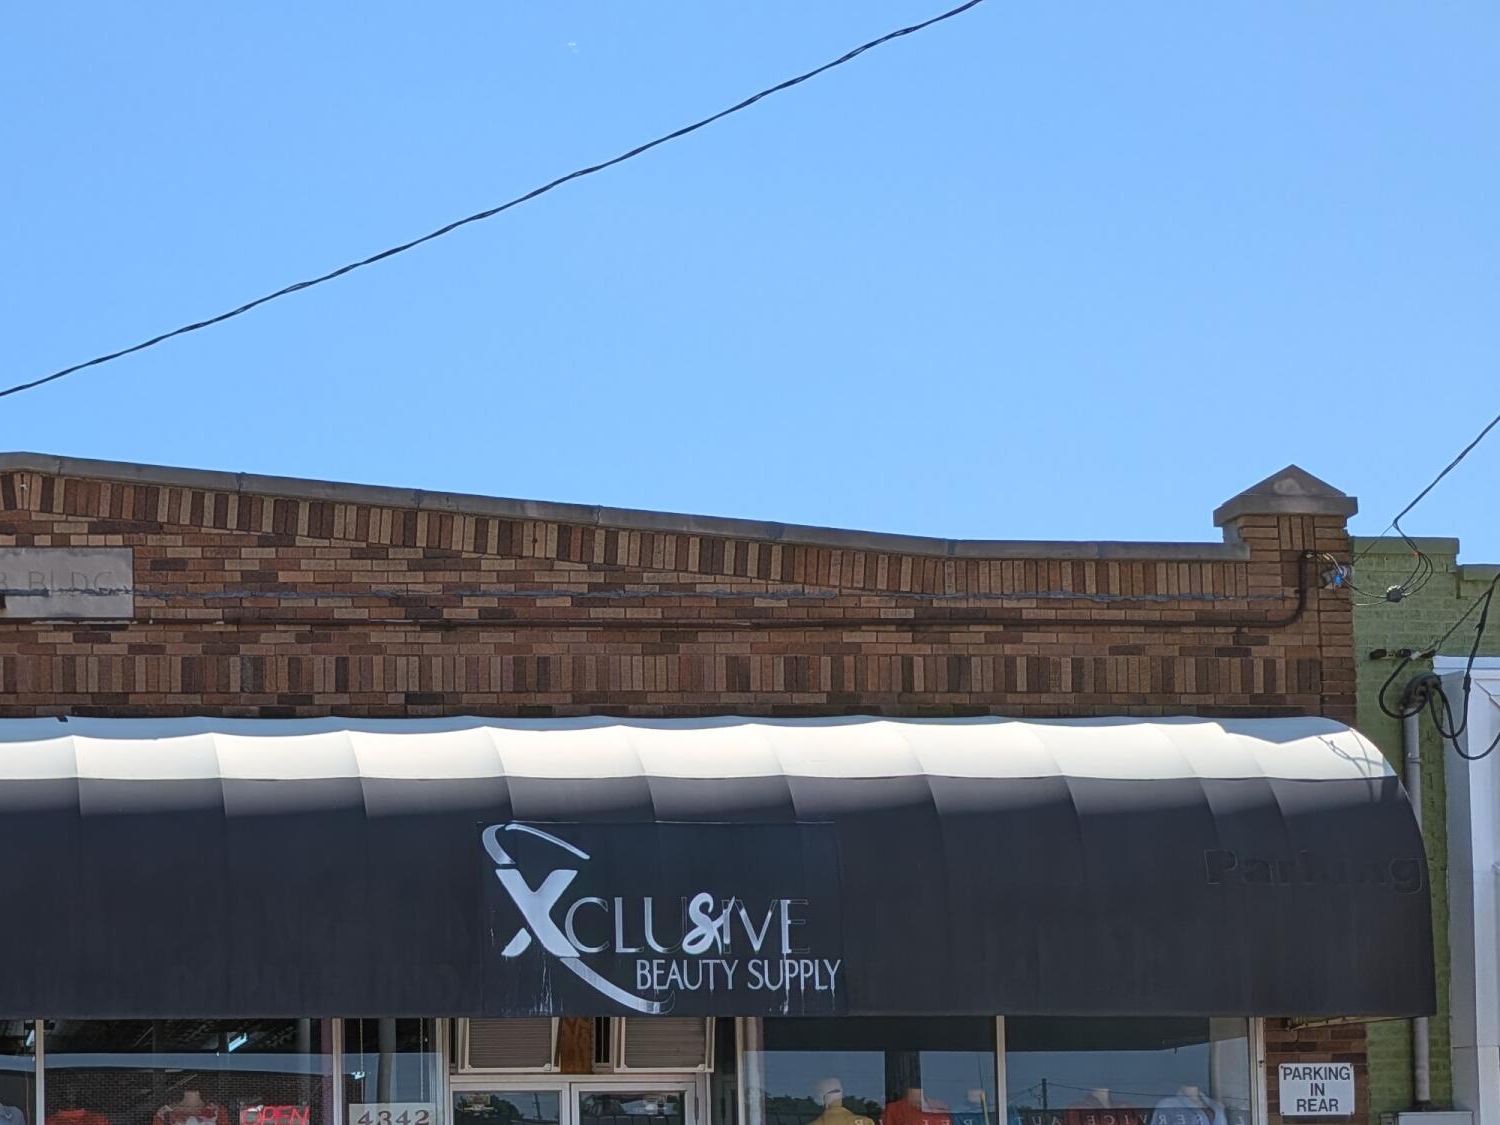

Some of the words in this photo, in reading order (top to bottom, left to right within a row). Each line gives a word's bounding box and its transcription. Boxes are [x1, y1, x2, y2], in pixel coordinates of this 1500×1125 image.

[636, 959, 739, 991] BEAUTY
[746, 959, 842, 991] SUPPLY
[1283, 1066, 1351, 1081] PARKING
[1310, 1082, 1325, 1097] IN
[1296, 1098, 1339, 1113] REAR
